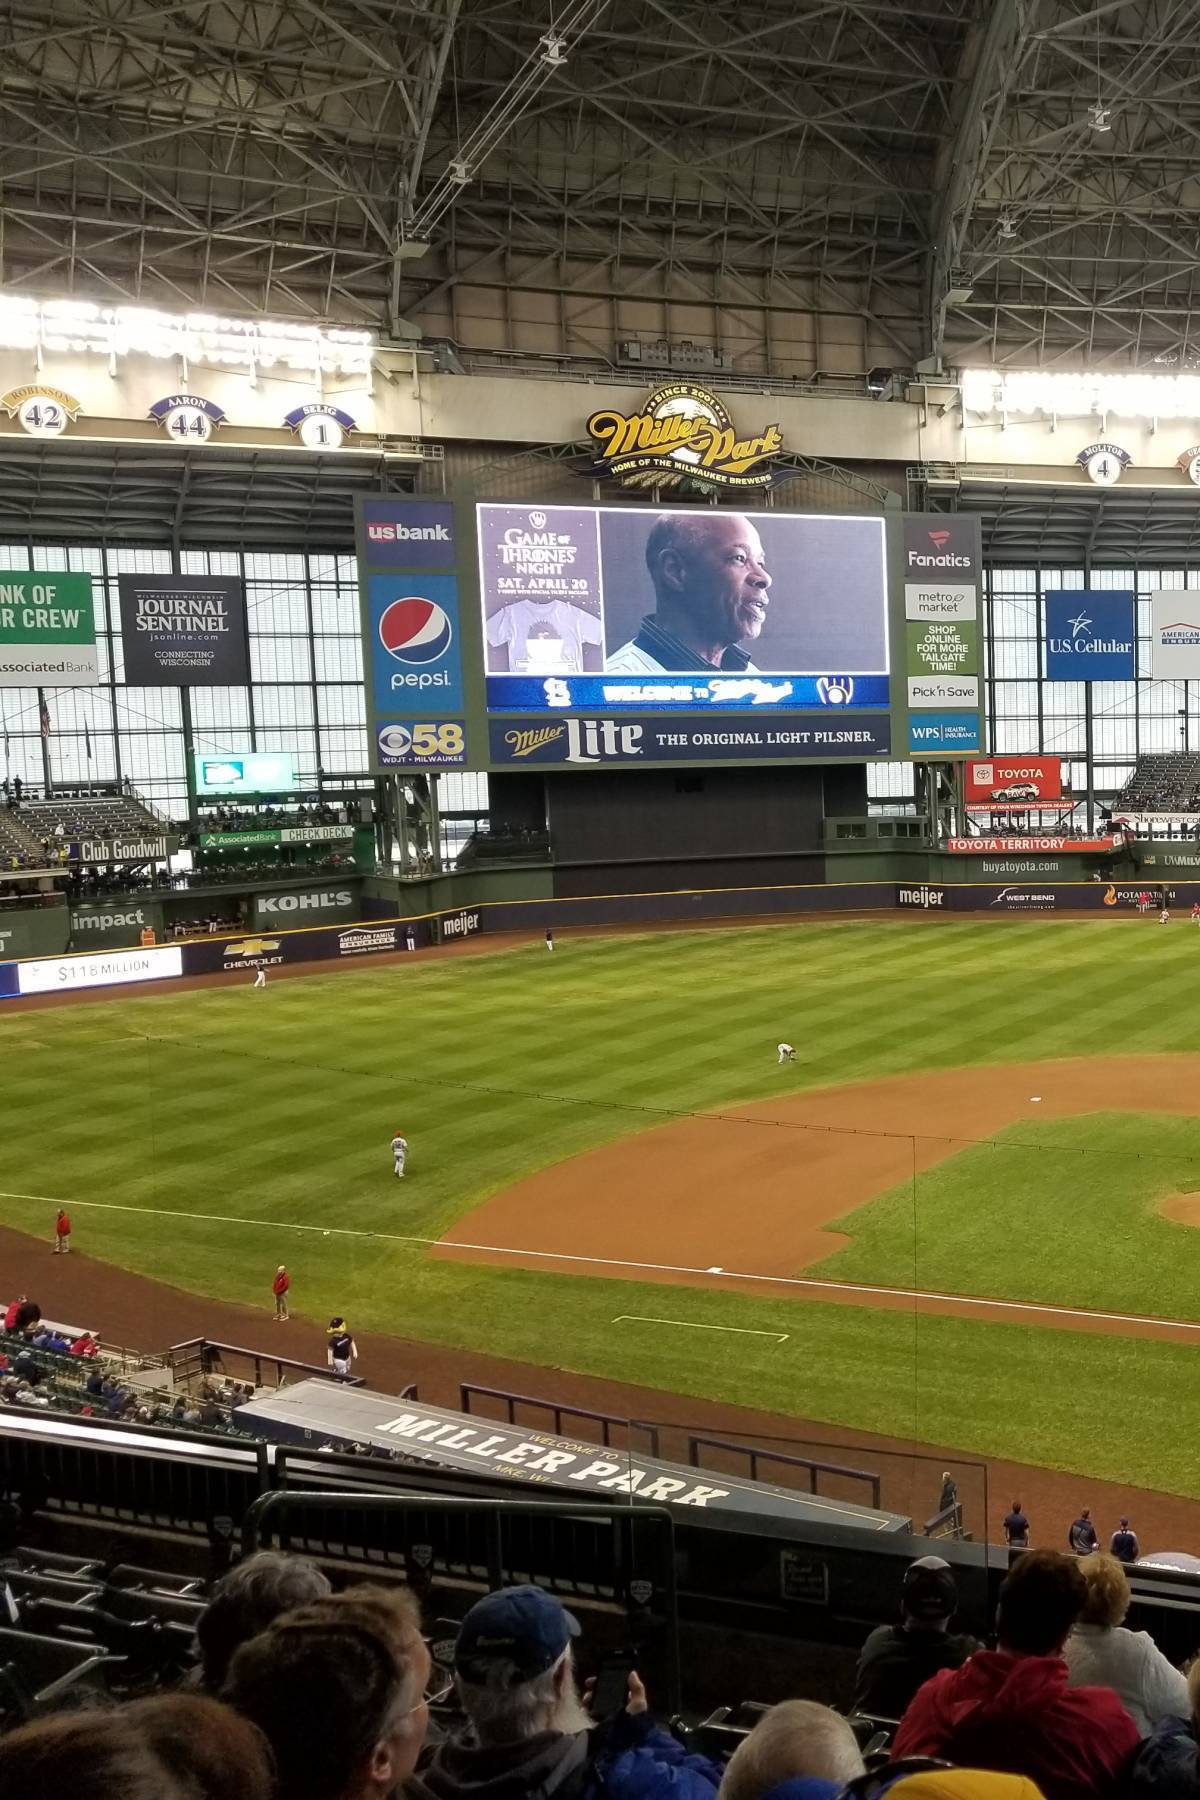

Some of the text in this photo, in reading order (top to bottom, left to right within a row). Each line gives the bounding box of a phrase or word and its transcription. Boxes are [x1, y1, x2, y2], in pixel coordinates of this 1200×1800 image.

[11, 385, 70, 402] ROBINSON
[655, 386, 715, 405] SINCE 2001
[168, 396, 207, 409] AARON
[303, 404, 337, 416] SELIG
[26, 405, 61, 428] 42
[172, 415, 206, 437] 44
[316, 424, 330, 445] 1
[590, 412, 782, 473] Miller Park
[1086, 445, 1123, 457] MOLITOR
[610, 458, 772, 486] HOME OF THE MILWAUKEE BREWERS
[1097, 459, 1109, 478] 4
[504, 528, 557, 545] GAME
[497, 545, 577, 564] THRONES
[908, 551, 971, 567] Fanatics
[516, 563, 565, 575] NIGHT
[528, 578, 569, 589] APRIL
[571, 579, 588, 590] 20
[32, 585, 56, 604] OF
[918, 592, 953, 602] metro
[136, 600, 228, 616] JOURNAL
[919, 602, 958, 612] market
[23, 609, 79, 628] CREW
[136, 616, 229, 632] SENTINEL
[928, 625, 956, 634] SHOP
[150, 633, 218, 642] jsonline.com
[924, 635, 961, 644] ONLINE
[917, 644, 969, 653] FOR MORE
[1050, 638, 1132, 653] U.S. Cellular
[155, 651, 215, 659] CONNECTING
[920, 653, 966, 662] TAILGATE
[930, 662, 957, 671] TIME!
[391, 670, 450, 690] pepsi
[912, 686, 935, 697] Pick
[947, 687, 975, 697] Save
[411, 724, 464, 756] 58
[505, 718, 876, 763] Miller Lite THE ORIGINAL LIGHT PILSNER.
[912, 727, 939, 739] WPS
[414, 755, 464, 763] MILWAUKEE
[997, 769, 1044, 778] TOYOTA
[289, 826, 347, 840] CHECK DECK
[82, 837, 166, 861] Club Goodwill
[951, 838, 1066, 850] TOYOTA TERRITORY
[983, 861, 1059, 874] buyatoyota.com
[258, 891, 352, 913] KOHL'S
[899, 886, 944, 908] meijer
[72, 909, 145, 931] impact
[444, 911, 478, 935] meijer
[340, 931, 395, 943] AMERICAN FAMILY
[101, 960, 149, 975] MILLION
[223, 956, 283, 969] CHEVROLET
[528, 1434, 620, 1461] WELCOME TO
[375, 1414, 731, 1507] MILLER PARK
